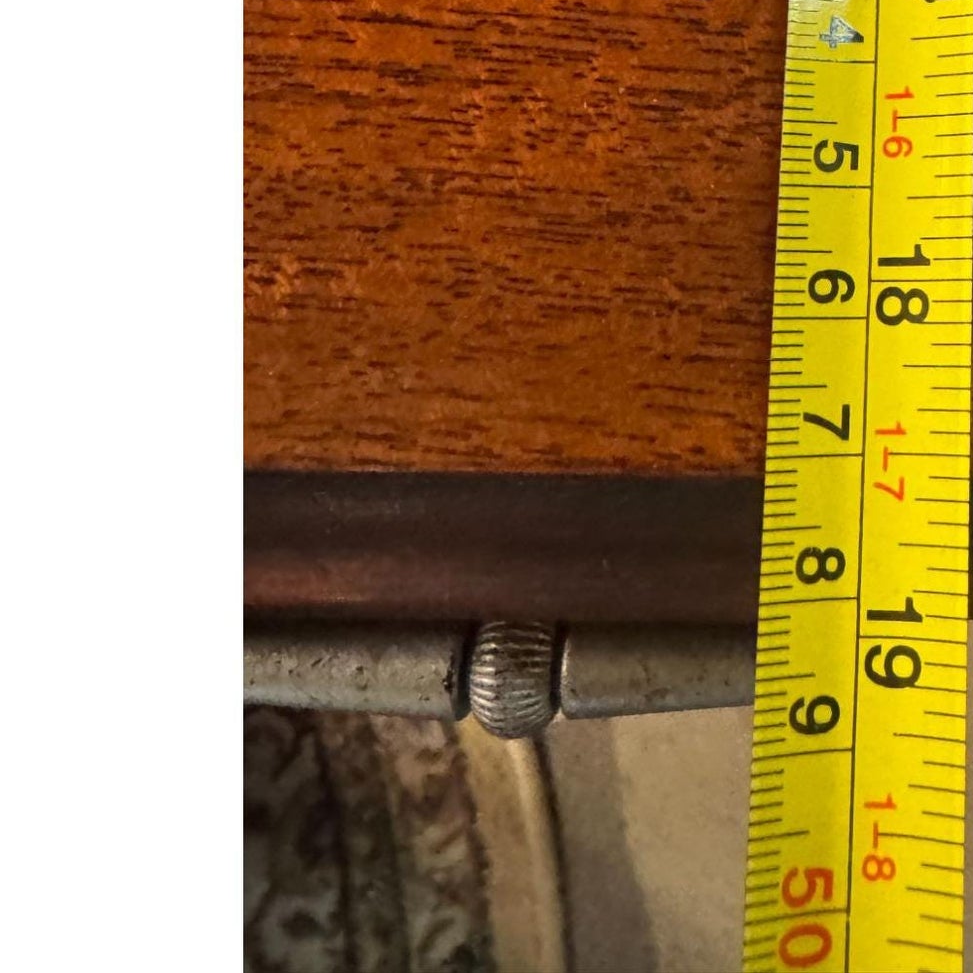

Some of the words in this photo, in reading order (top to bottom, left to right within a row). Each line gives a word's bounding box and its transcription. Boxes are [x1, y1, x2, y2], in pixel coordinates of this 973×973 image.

[819, 15, 864, 48] 4
[813, 139, 859, 172] 5
[808, 270, 855, 304] 6
[876, 244, 931, 326] 18
[802, 404, 850, 441] 7
[795, 547, 846, 584] 8
[864, 597, 923, 688] 19
[789, 695, 840, 734] 9
[779, 867, 834, 968] 50
